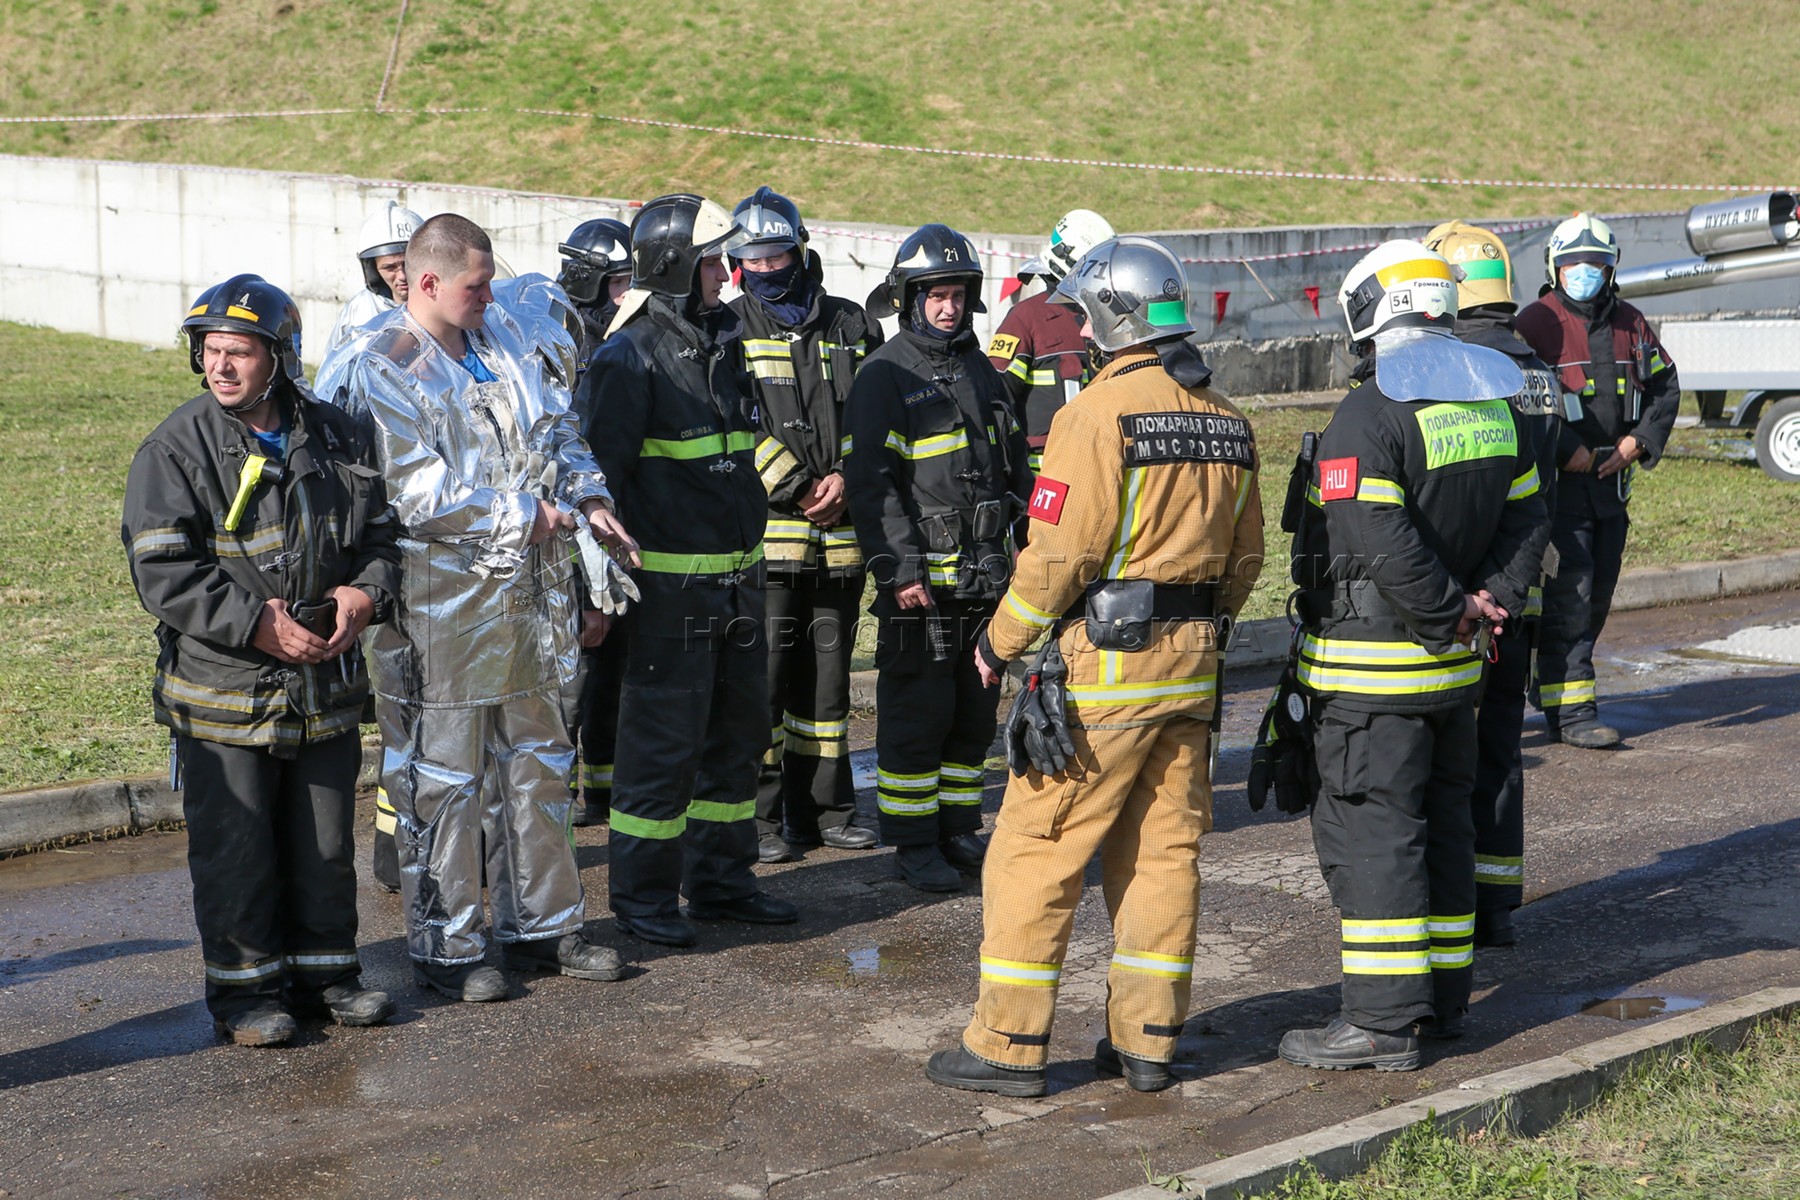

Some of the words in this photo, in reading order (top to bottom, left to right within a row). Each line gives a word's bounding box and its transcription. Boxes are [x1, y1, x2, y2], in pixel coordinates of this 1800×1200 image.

[1704, 210, 1740, 229] ПУРГА
[1744, 207, 1759, 223] 90
[396, 222, 413, 238] 89
[1453, 244, 1480, 260] 47
[1664, 263, 1724, 281] SnowStorm
[240, 292, 250, 306] 4
[1392, 294, 1409, 307] 54
[990, 339, 1013, 353] 291
[751, 405, 760, 424] 4
[1425, 408, 1479, 433] ПОЖАРНАЯ
[1135, 416, 1202, 434] ПОЖАРНАЯ
[1206, 418, 1248, 438] ОХРАНА
[1188, 438, 1250, 461] РОССИИ
[1432, 432, 1466, 454] МЧС
[1473, 427, 1514, 446] РОССИИ
[1325, 468, 1348, 491] НШ
[1033, 487, 1057, 511] НТ
